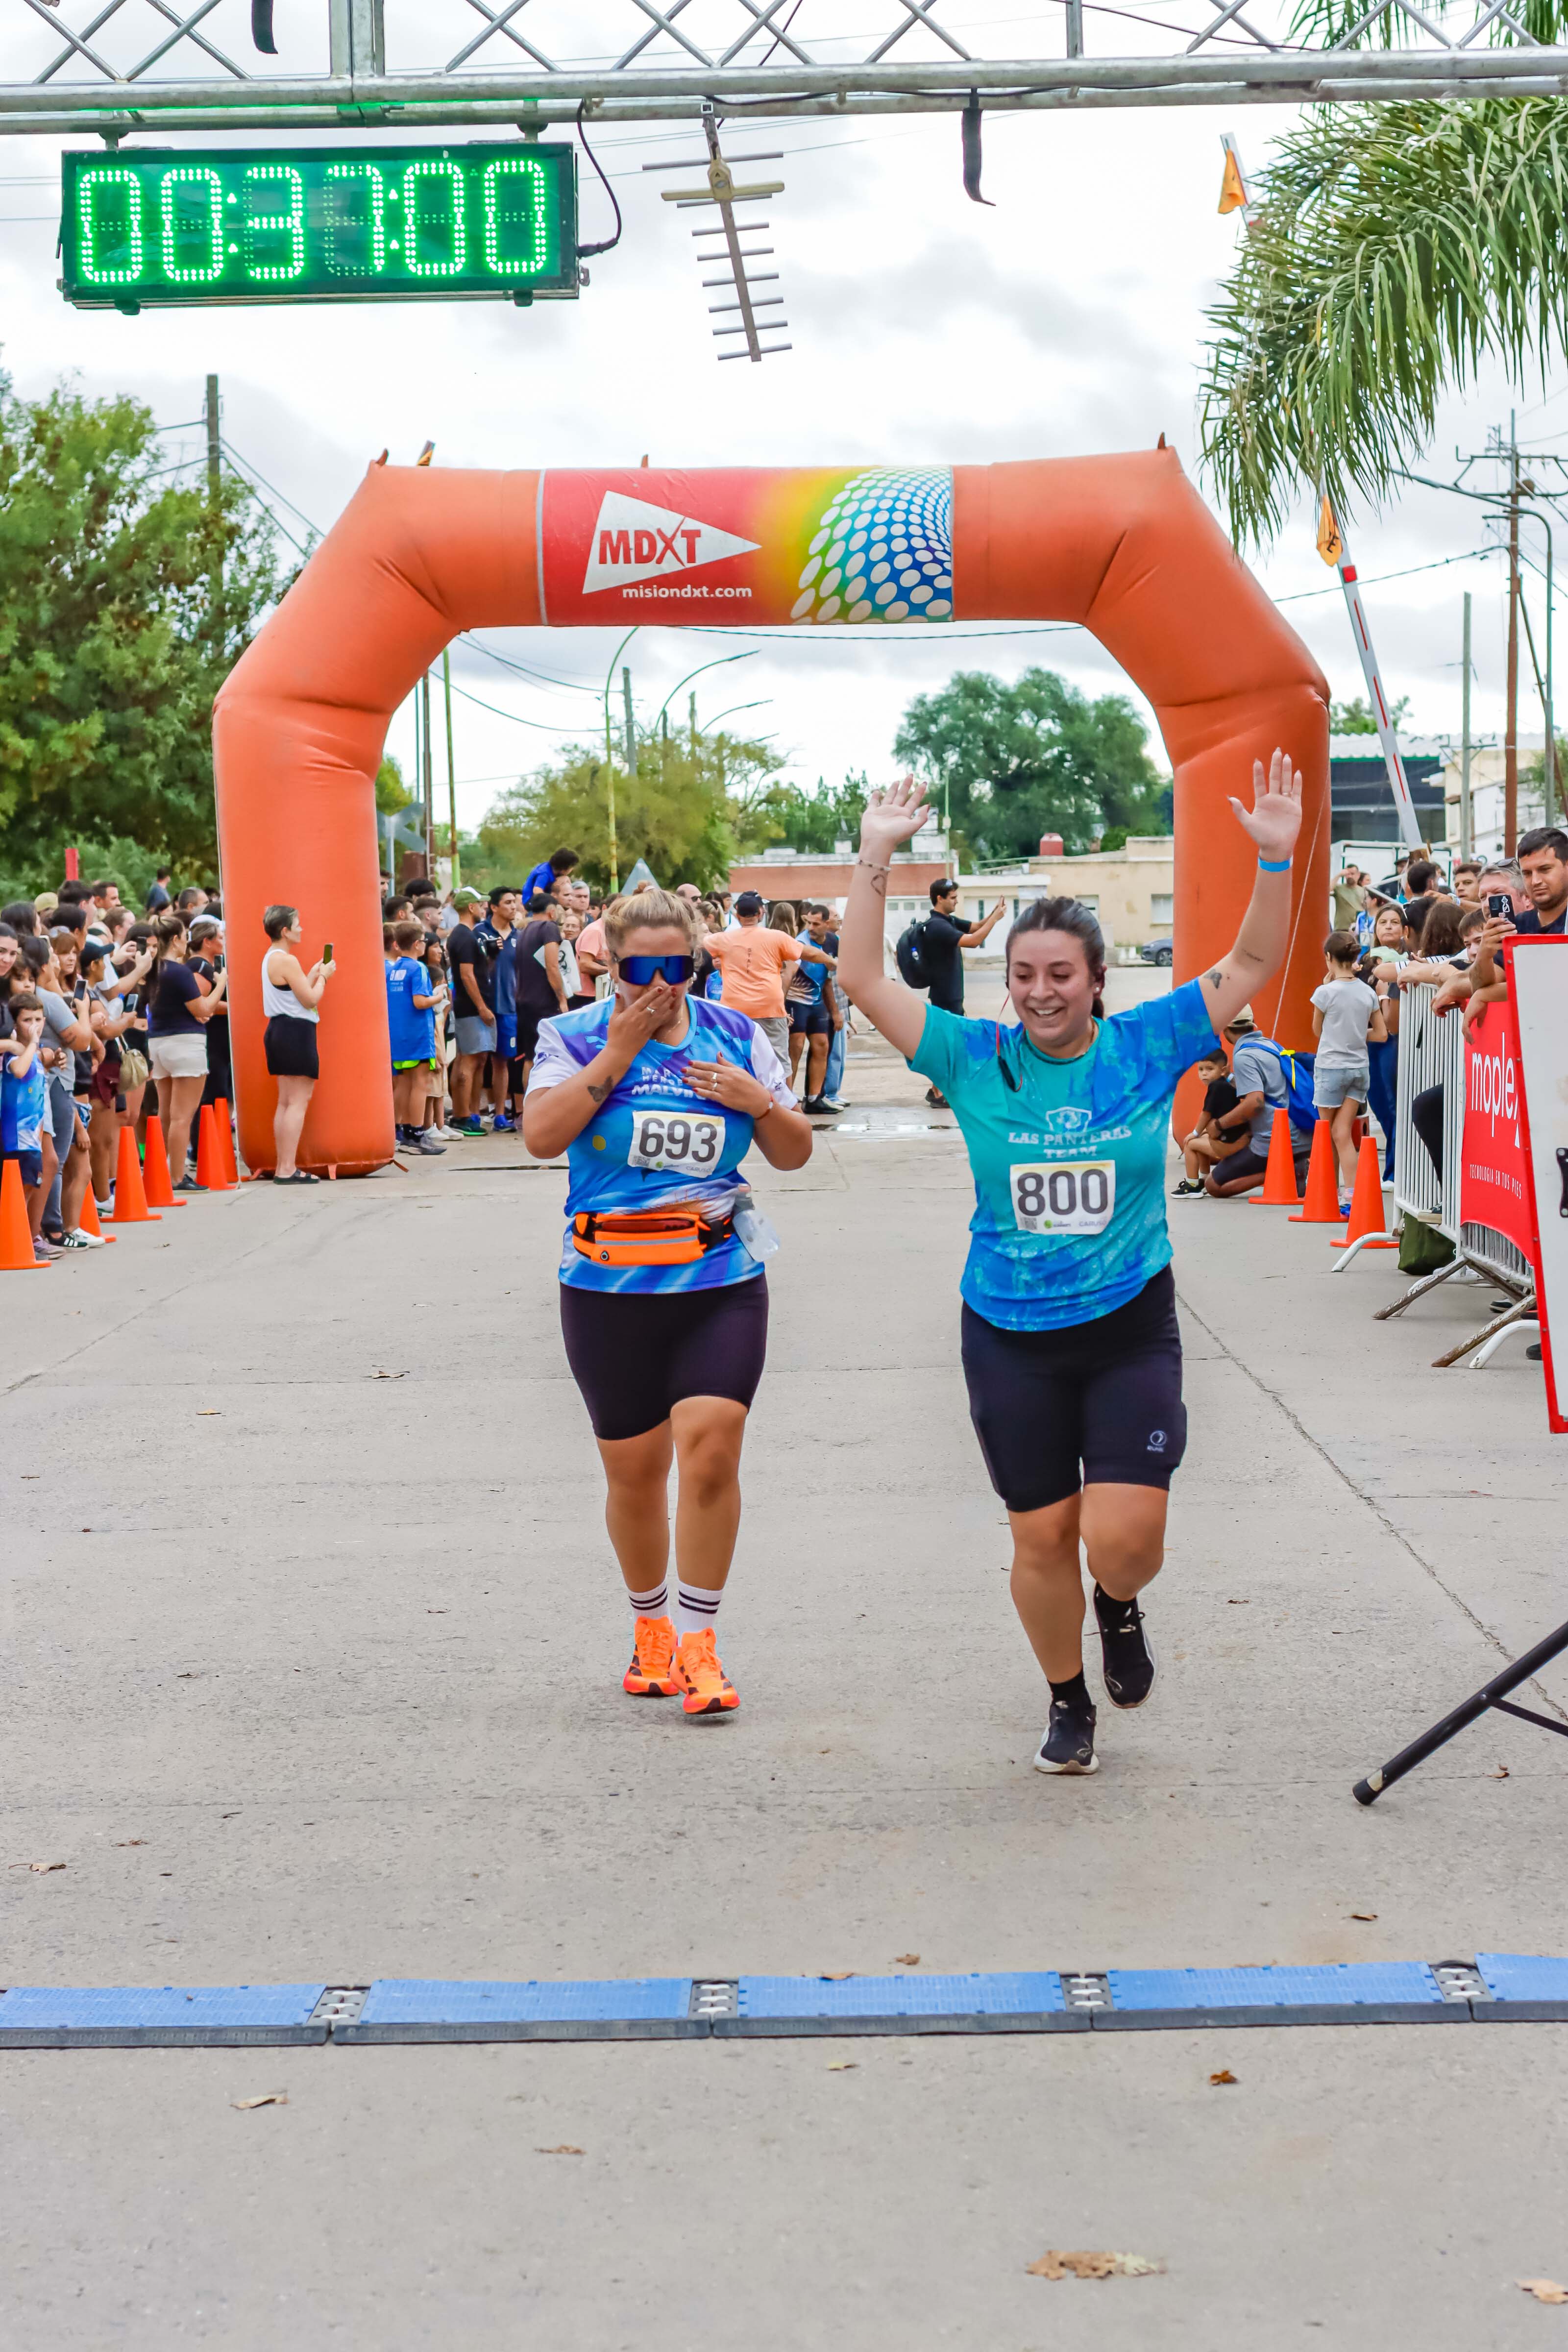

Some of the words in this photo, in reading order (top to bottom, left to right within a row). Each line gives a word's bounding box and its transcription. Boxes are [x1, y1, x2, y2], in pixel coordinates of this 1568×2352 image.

[79, 159, 545, 283] 00:37:00
[599, 516, 701, 567] MDXT
[622, 584, 752, 598] misiondxt.com
[632, 1084, 707, 1100] MALVIN
[1471, 1031, 1519, 1138] mople
[639, 1117, 717, 1163] 693
[1008, 1132, 1039, 1145] LAS
[1044, 1126, 1132, 1146] PANTERAS
[1043, 1145, 1098, 1159] TEAM
[1017, 1169, 1108, 1217] 800
[1470, 1164, 1494, 1184] TECNOLOGIA
[1495, 1170, 1500, 1186] EN
[1512, 1177, 1521, 1200] PIES
